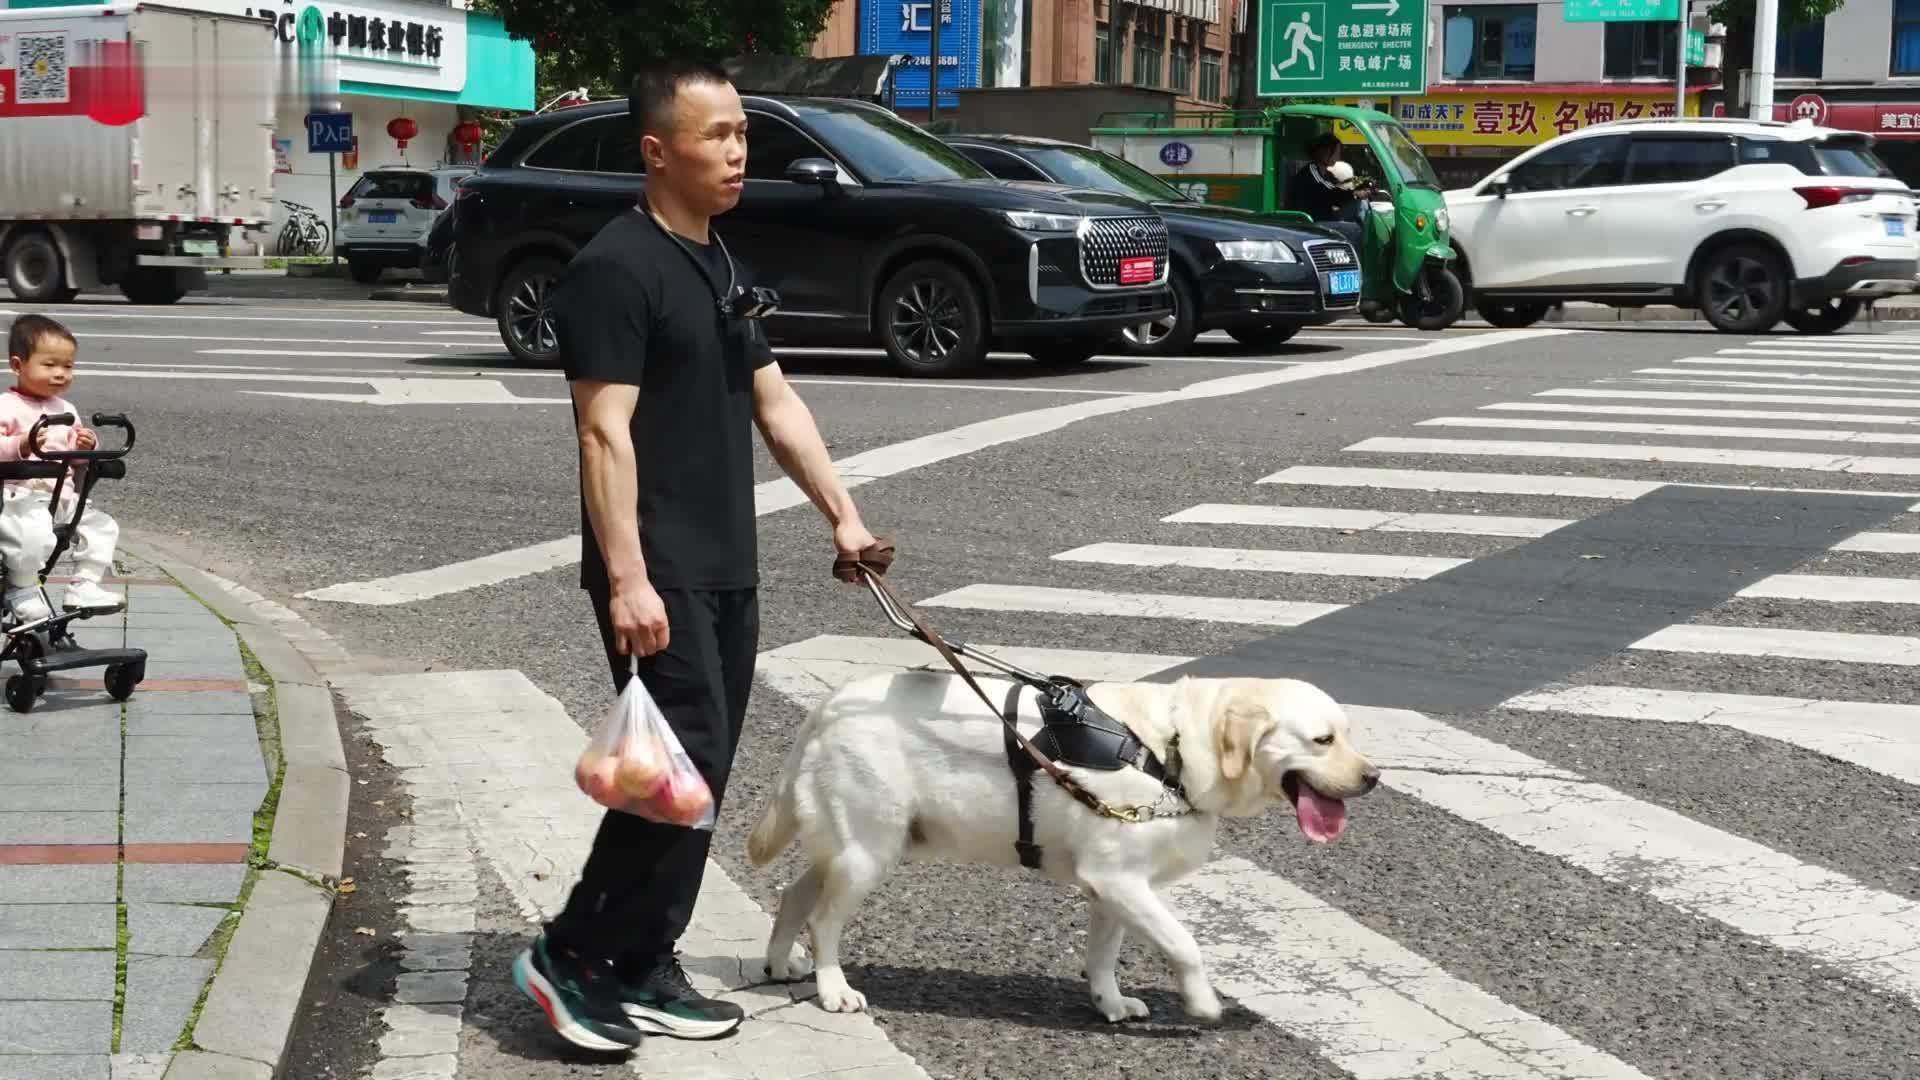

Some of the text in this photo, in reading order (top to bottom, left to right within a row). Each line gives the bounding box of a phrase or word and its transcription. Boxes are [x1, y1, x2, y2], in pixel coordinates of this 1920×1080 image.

[246, 8, 295, 42] BC
[902, 4, 931, 31] 汇
[327, 12, 443, 57] 中国农业银行
[1337, 24, 1412, 38] 应急避难场所
[1338, 56, 1412, 71] 灵龟峰广场
[1401, 104, 1465, 119] 和成天下
